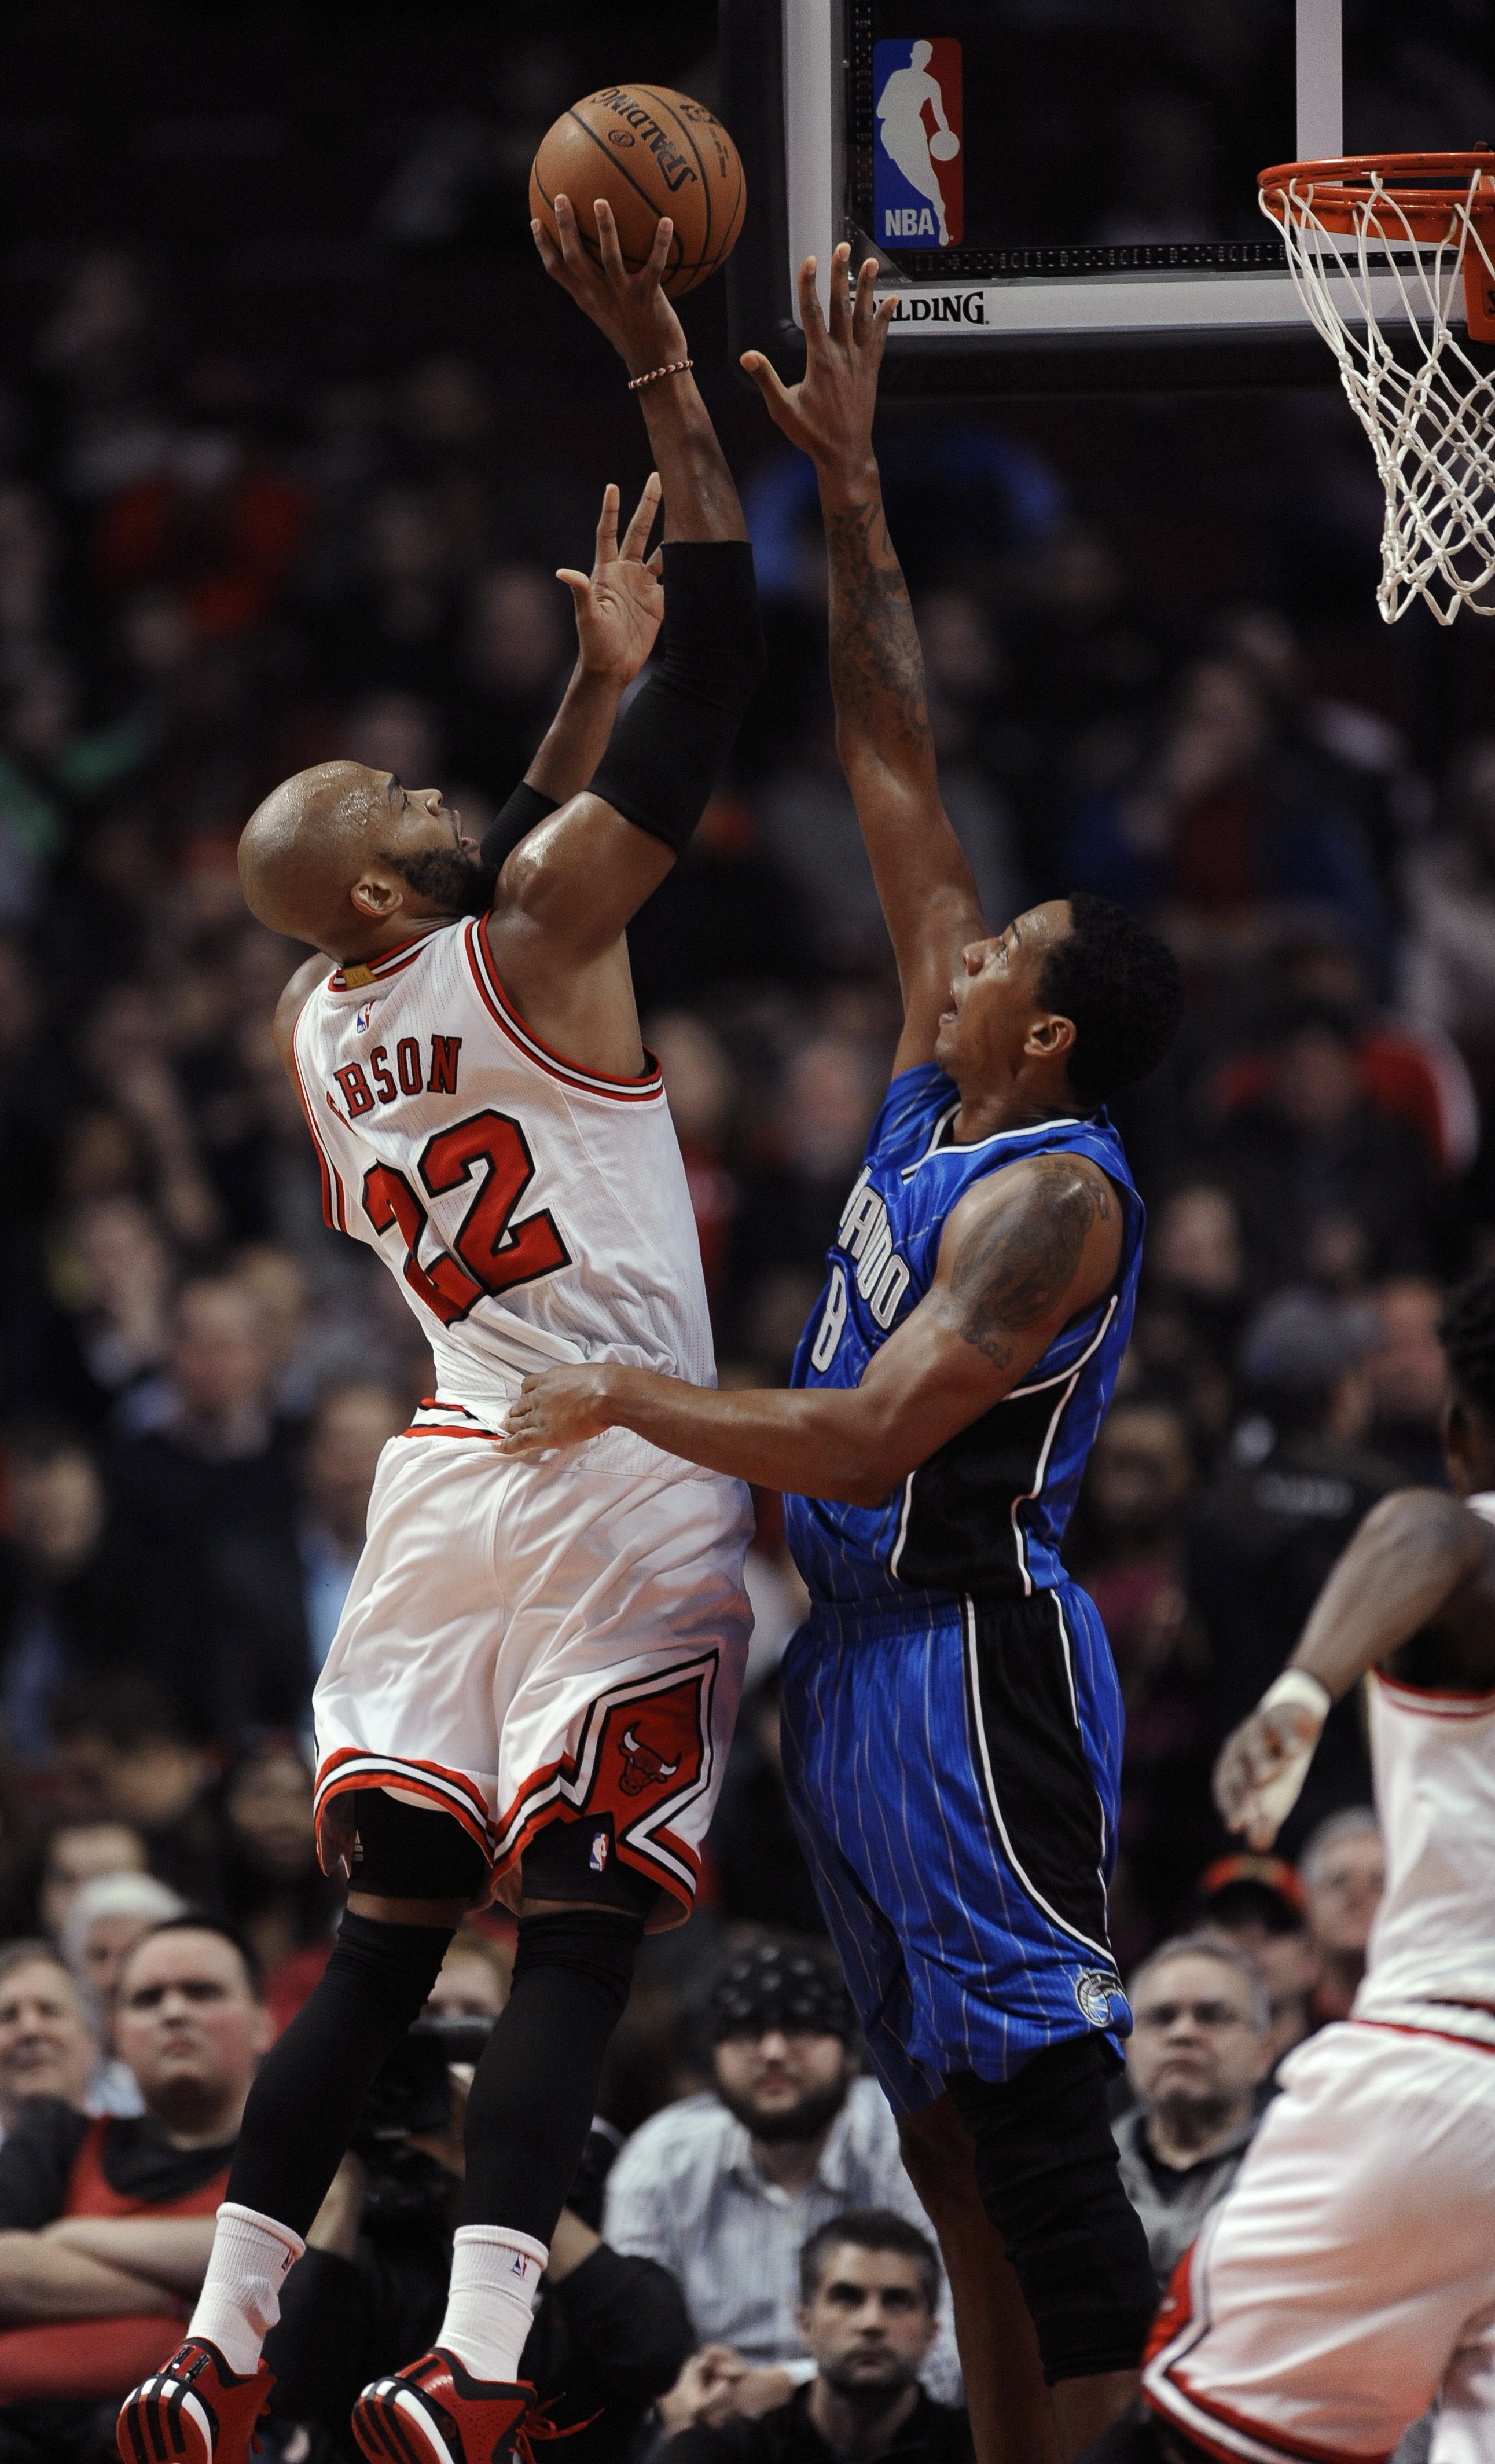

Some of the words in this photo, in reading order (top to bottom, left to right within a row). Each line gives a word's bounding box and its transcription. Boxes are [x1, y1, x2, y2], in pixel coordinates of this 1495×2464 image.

[590, 88, 697, 192] SPALDING
[885, 208, 935, 236] NBA
[850, 291, 984, 325] LDING
[326, 1033, 462, 1136] BSON
[362, 1108, 573, 1329] 22
[811, 1264, 847, 1372] 8
